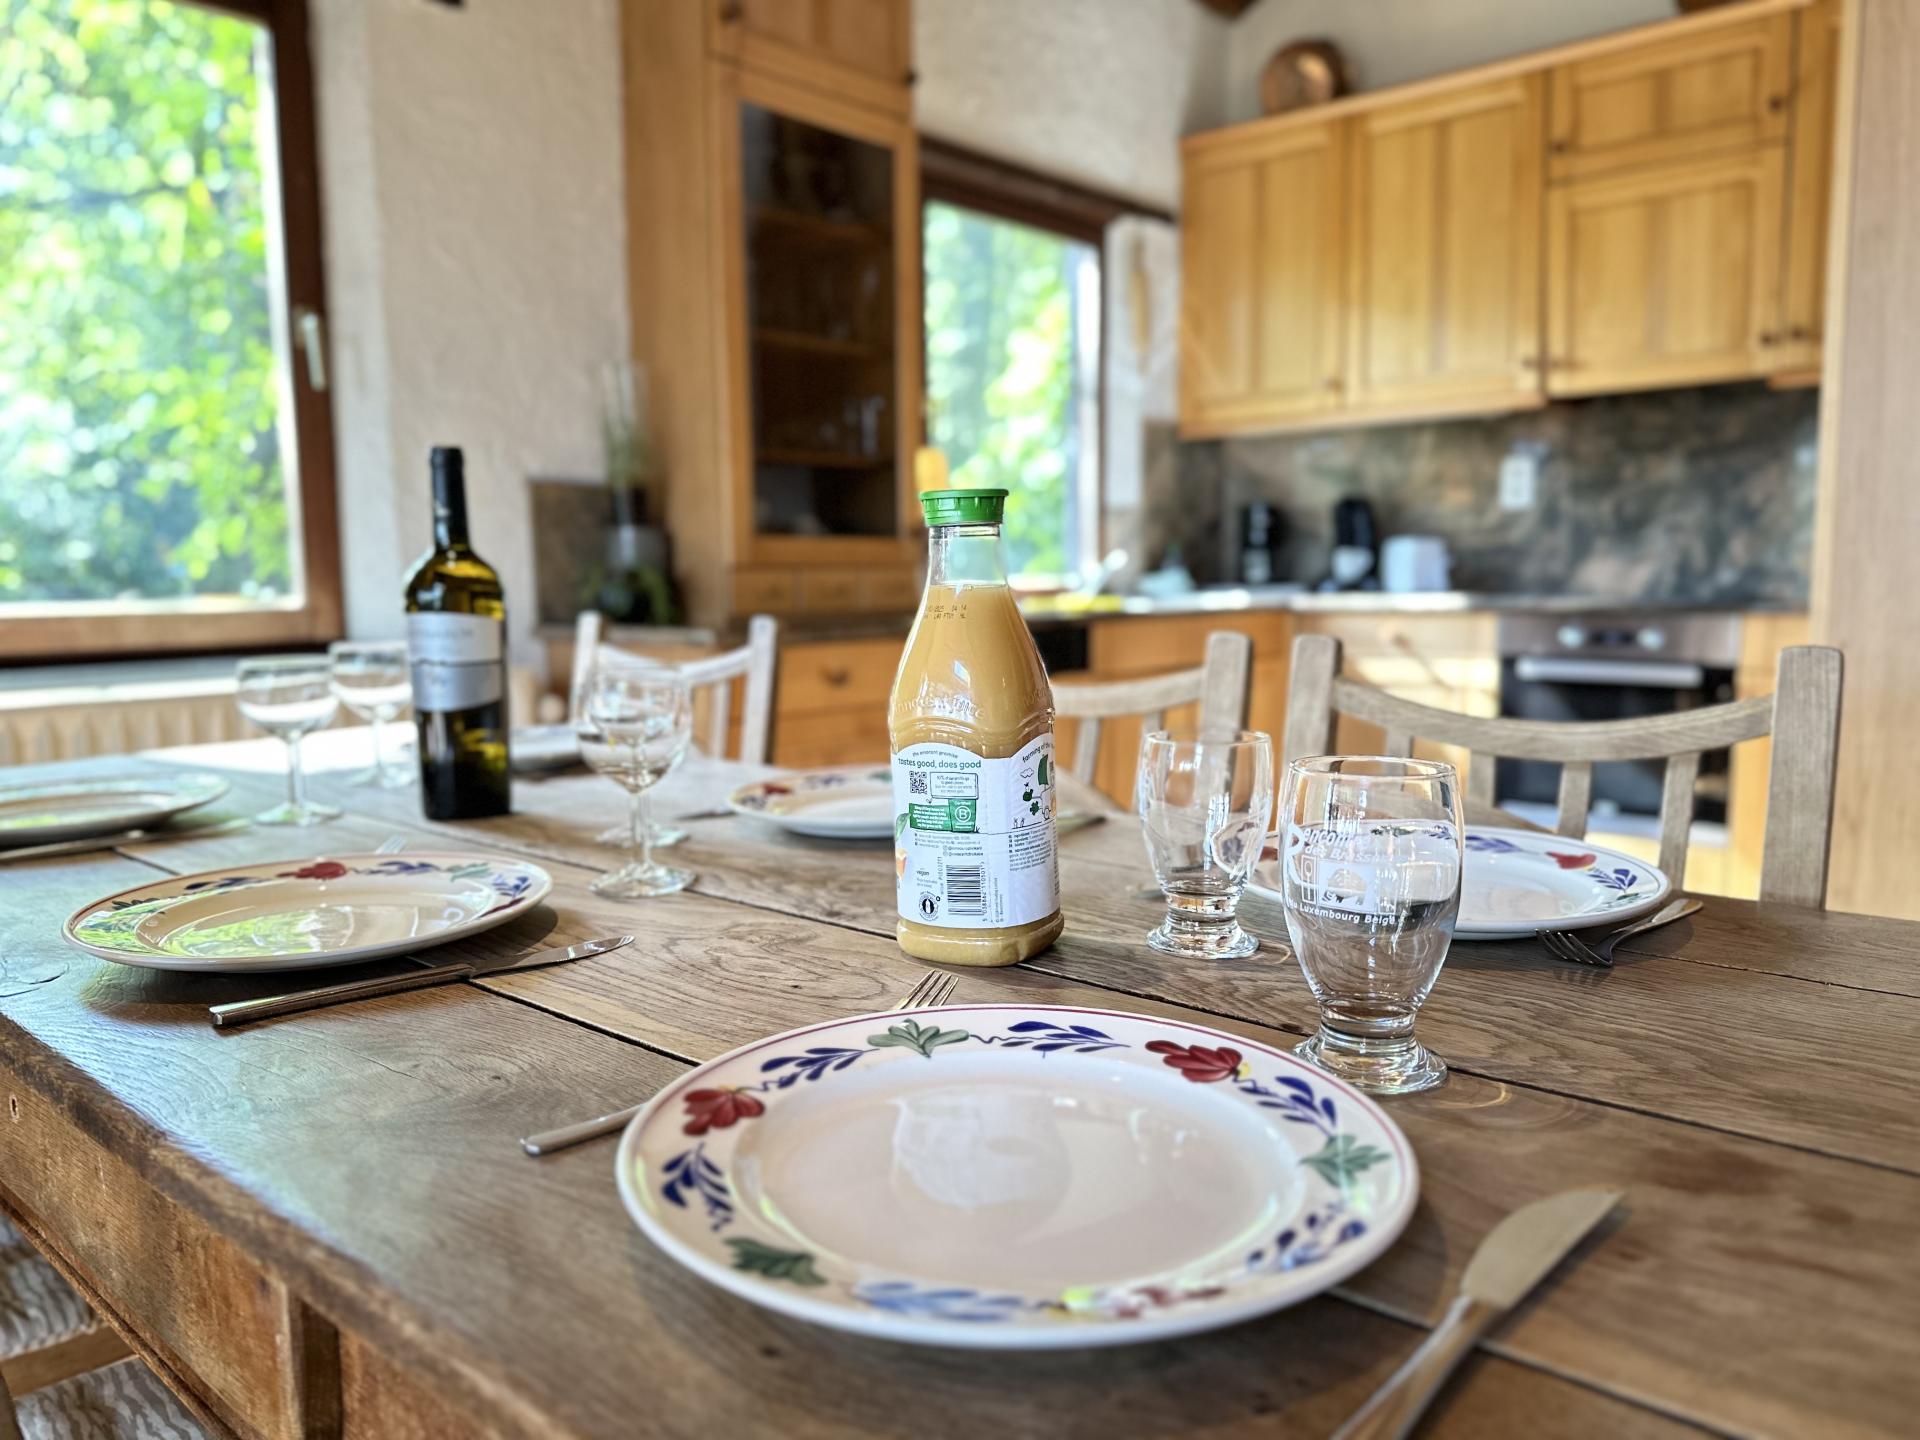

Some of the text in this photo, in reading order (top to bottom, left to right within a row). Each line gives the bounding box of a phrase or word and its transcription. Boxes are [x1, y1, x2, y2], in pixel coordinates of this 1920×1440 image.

[898, 758, 982, 770] tastes good, does good
[1300, 903, 1360, 923] Luxembourg
